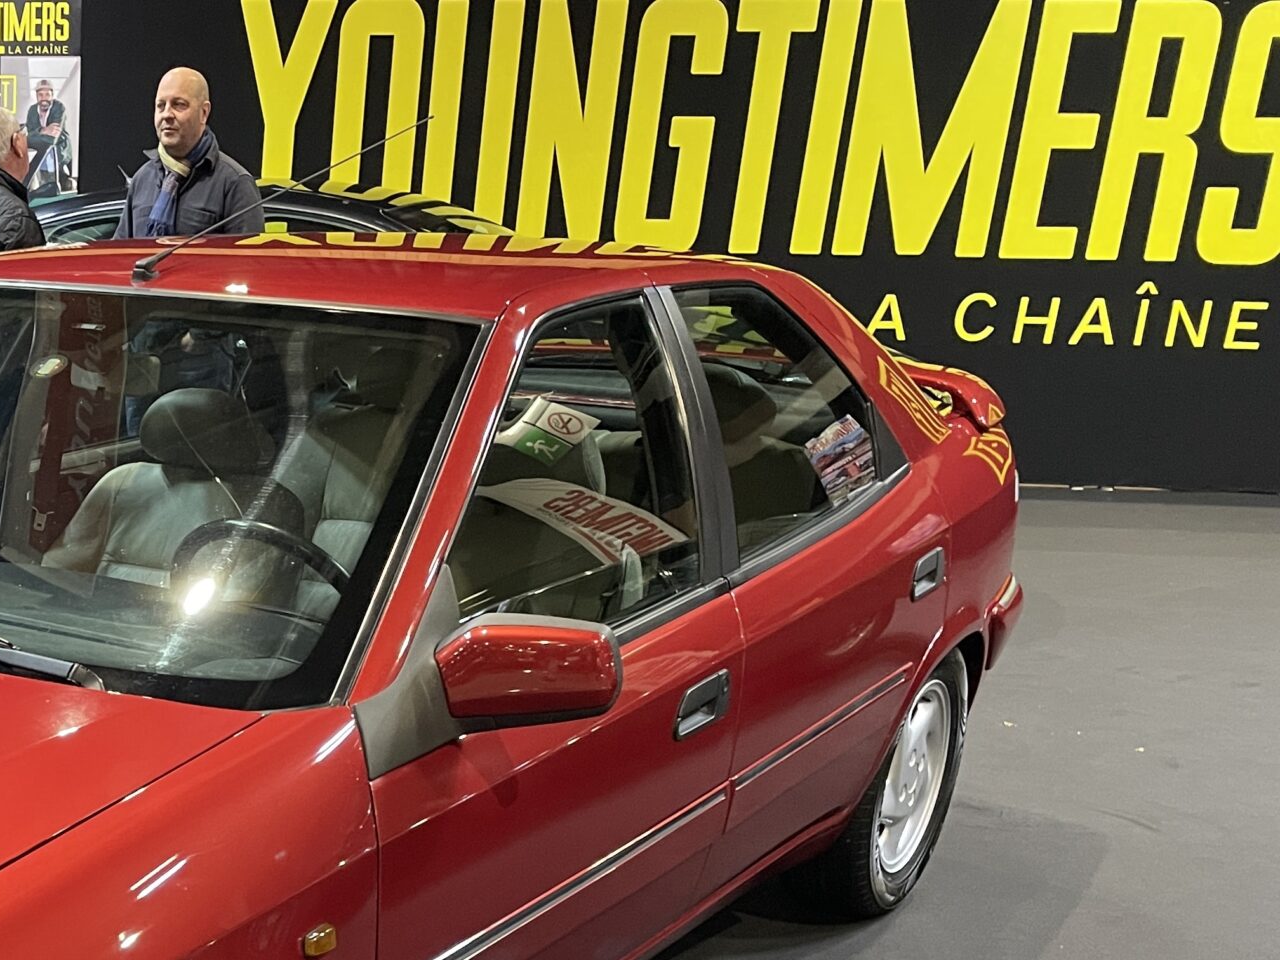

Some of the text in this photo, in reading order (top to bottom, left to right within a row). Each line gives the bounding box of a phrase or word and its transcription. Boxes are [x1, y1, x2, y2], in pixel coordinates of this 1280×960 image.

[7, 43, 69, 55] LA CHAÎNE
[237, 0, 1280, 265] YOUNGTIMERS
[866, 281, 1270, 350] A CHAÎNE
